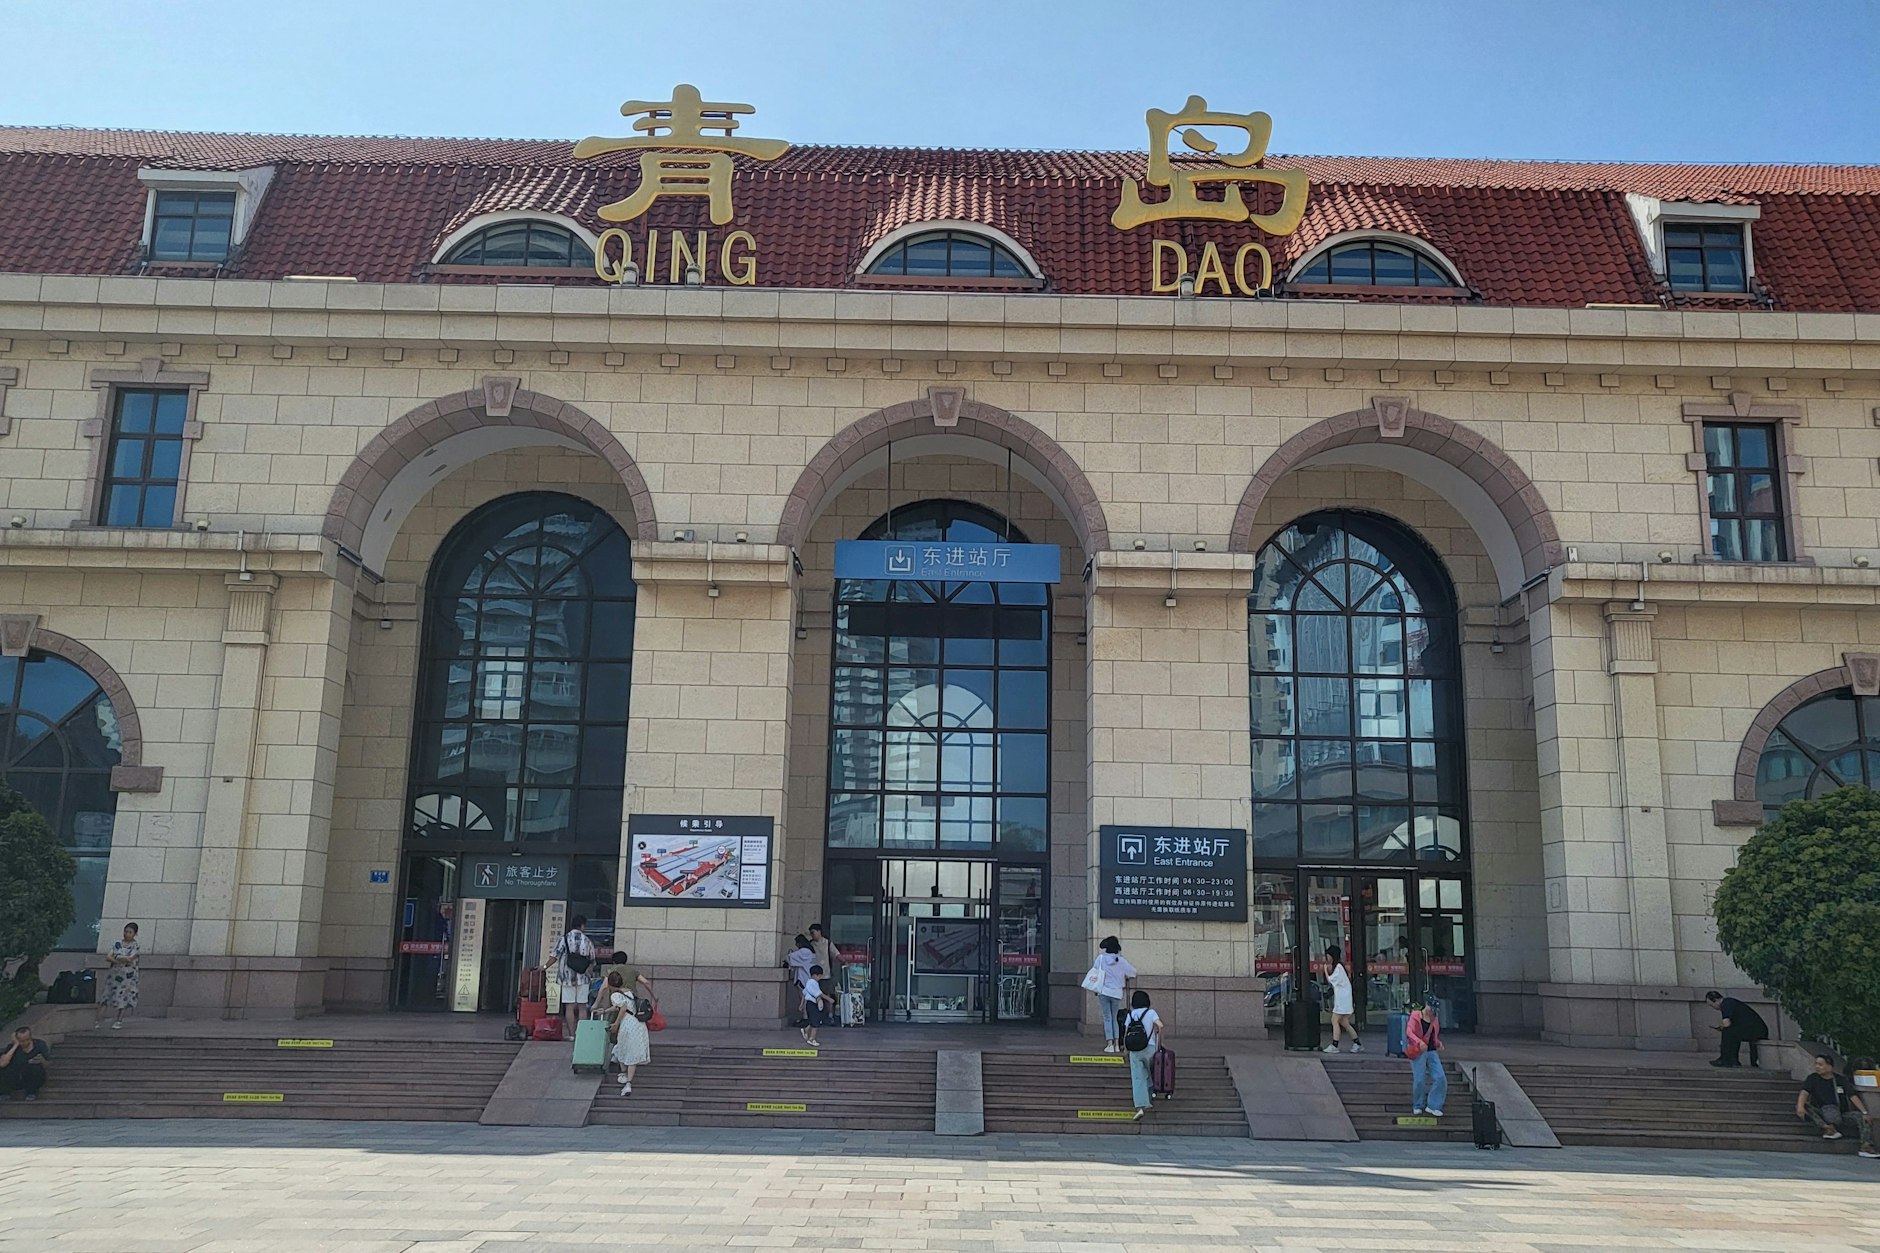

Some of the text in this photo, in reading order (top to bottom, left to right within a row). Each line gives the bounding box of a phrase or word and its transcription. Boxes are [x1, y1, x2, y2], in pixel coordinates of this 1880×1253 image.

[573, 84, 1310, 236] 青 岛
[595, 228, 1273, 295] QING DAO
[922, 547, 1012, 567] 东进站厅
[1154, 836, 1230, 857] 东进站厅
[1154, 857, 1214, 867] East Entrance
[505, 865, 558, 879] 旅客止步
[1115, 876, 1180, 885] 东进站厅工作时间
[1115, 887, 1180, 896] 西进站厅工作时间
